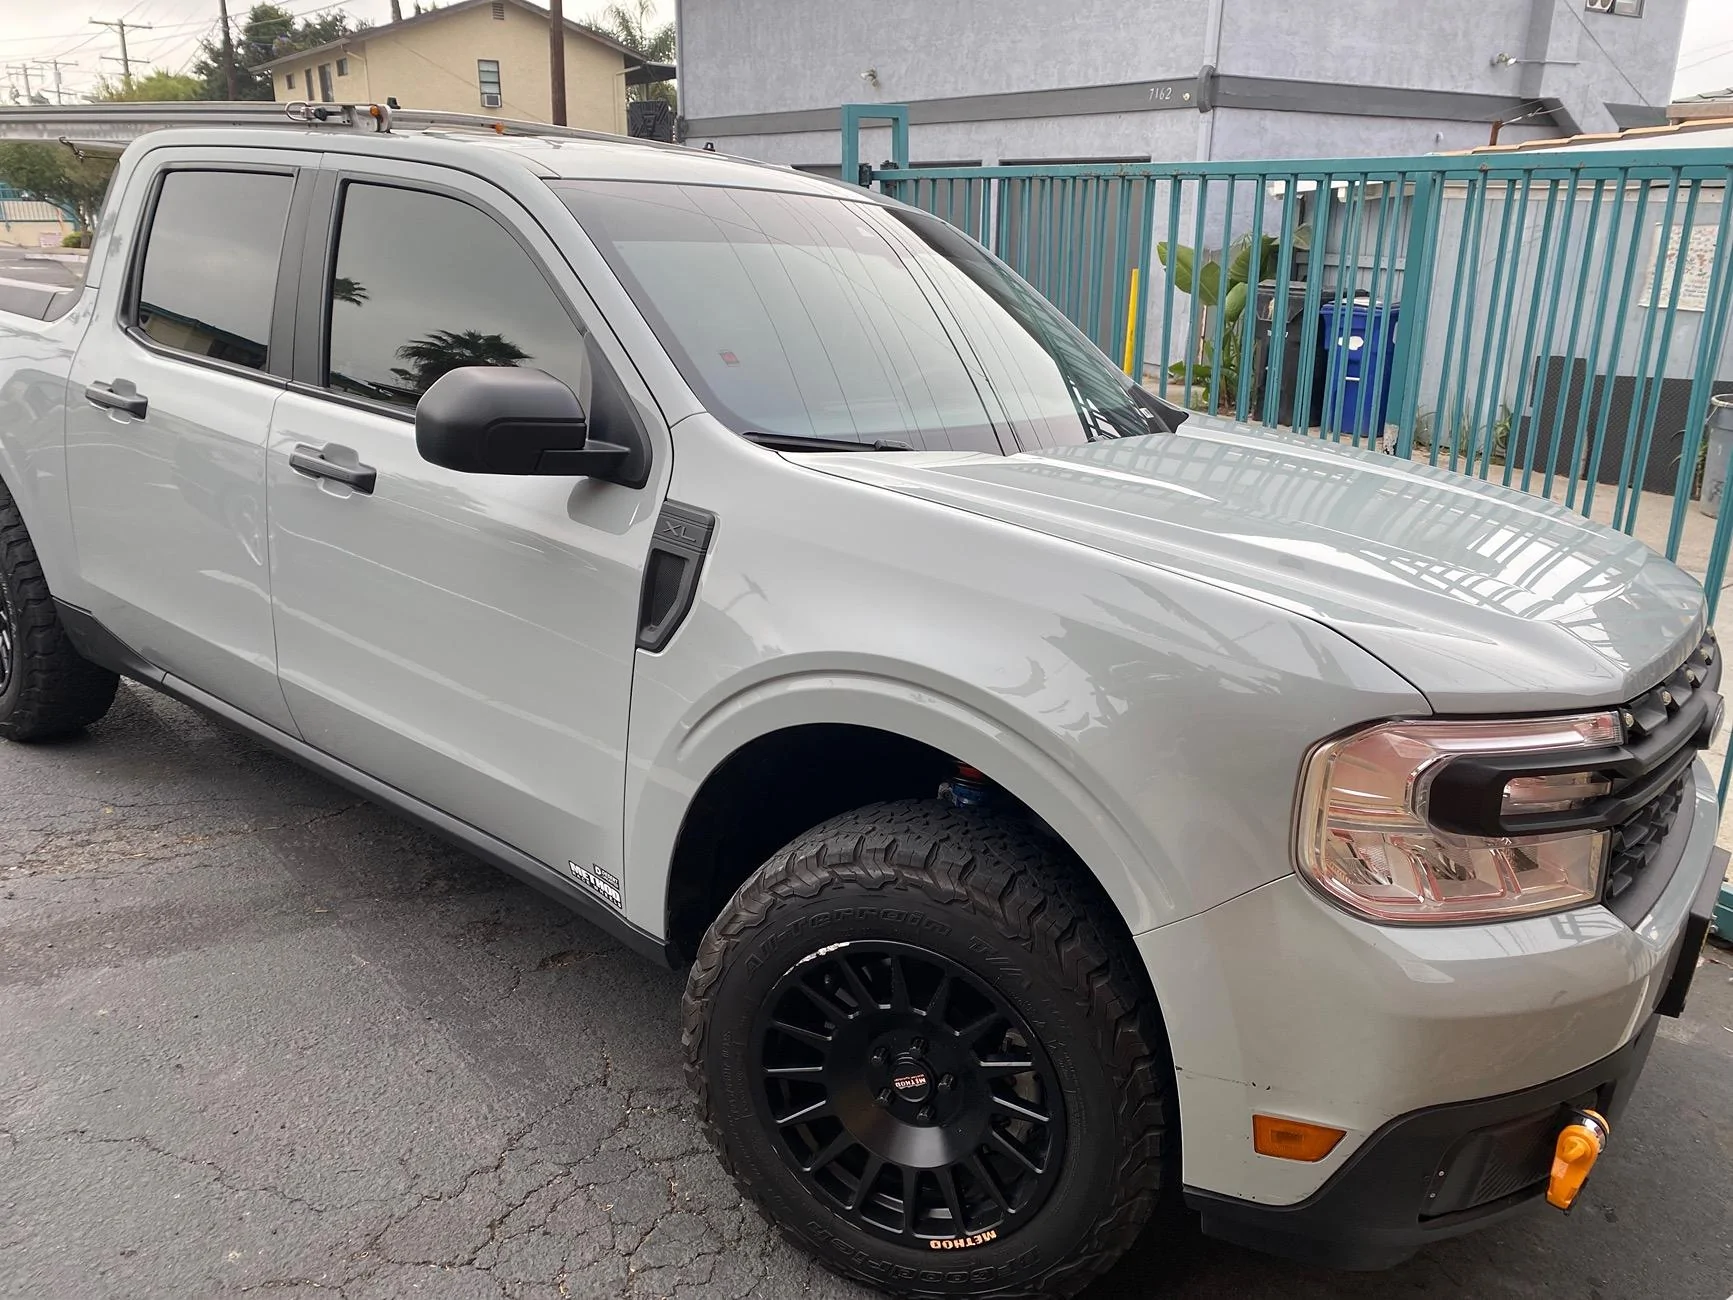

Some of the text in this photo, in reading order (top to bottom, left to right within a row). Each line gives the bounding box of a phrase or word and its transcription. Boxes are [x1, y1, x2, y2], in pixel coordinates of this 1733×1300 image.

[1148, 87, 1172, 101] 7162
[663, 520, 697, 543] XL
[569, 861, 621, 902] METHOD
[744, 906, 953, 980] All-Terrain
[894, 1077, 926, 1088] METHOD
[929, 1230, 997, 1250] METHOD
